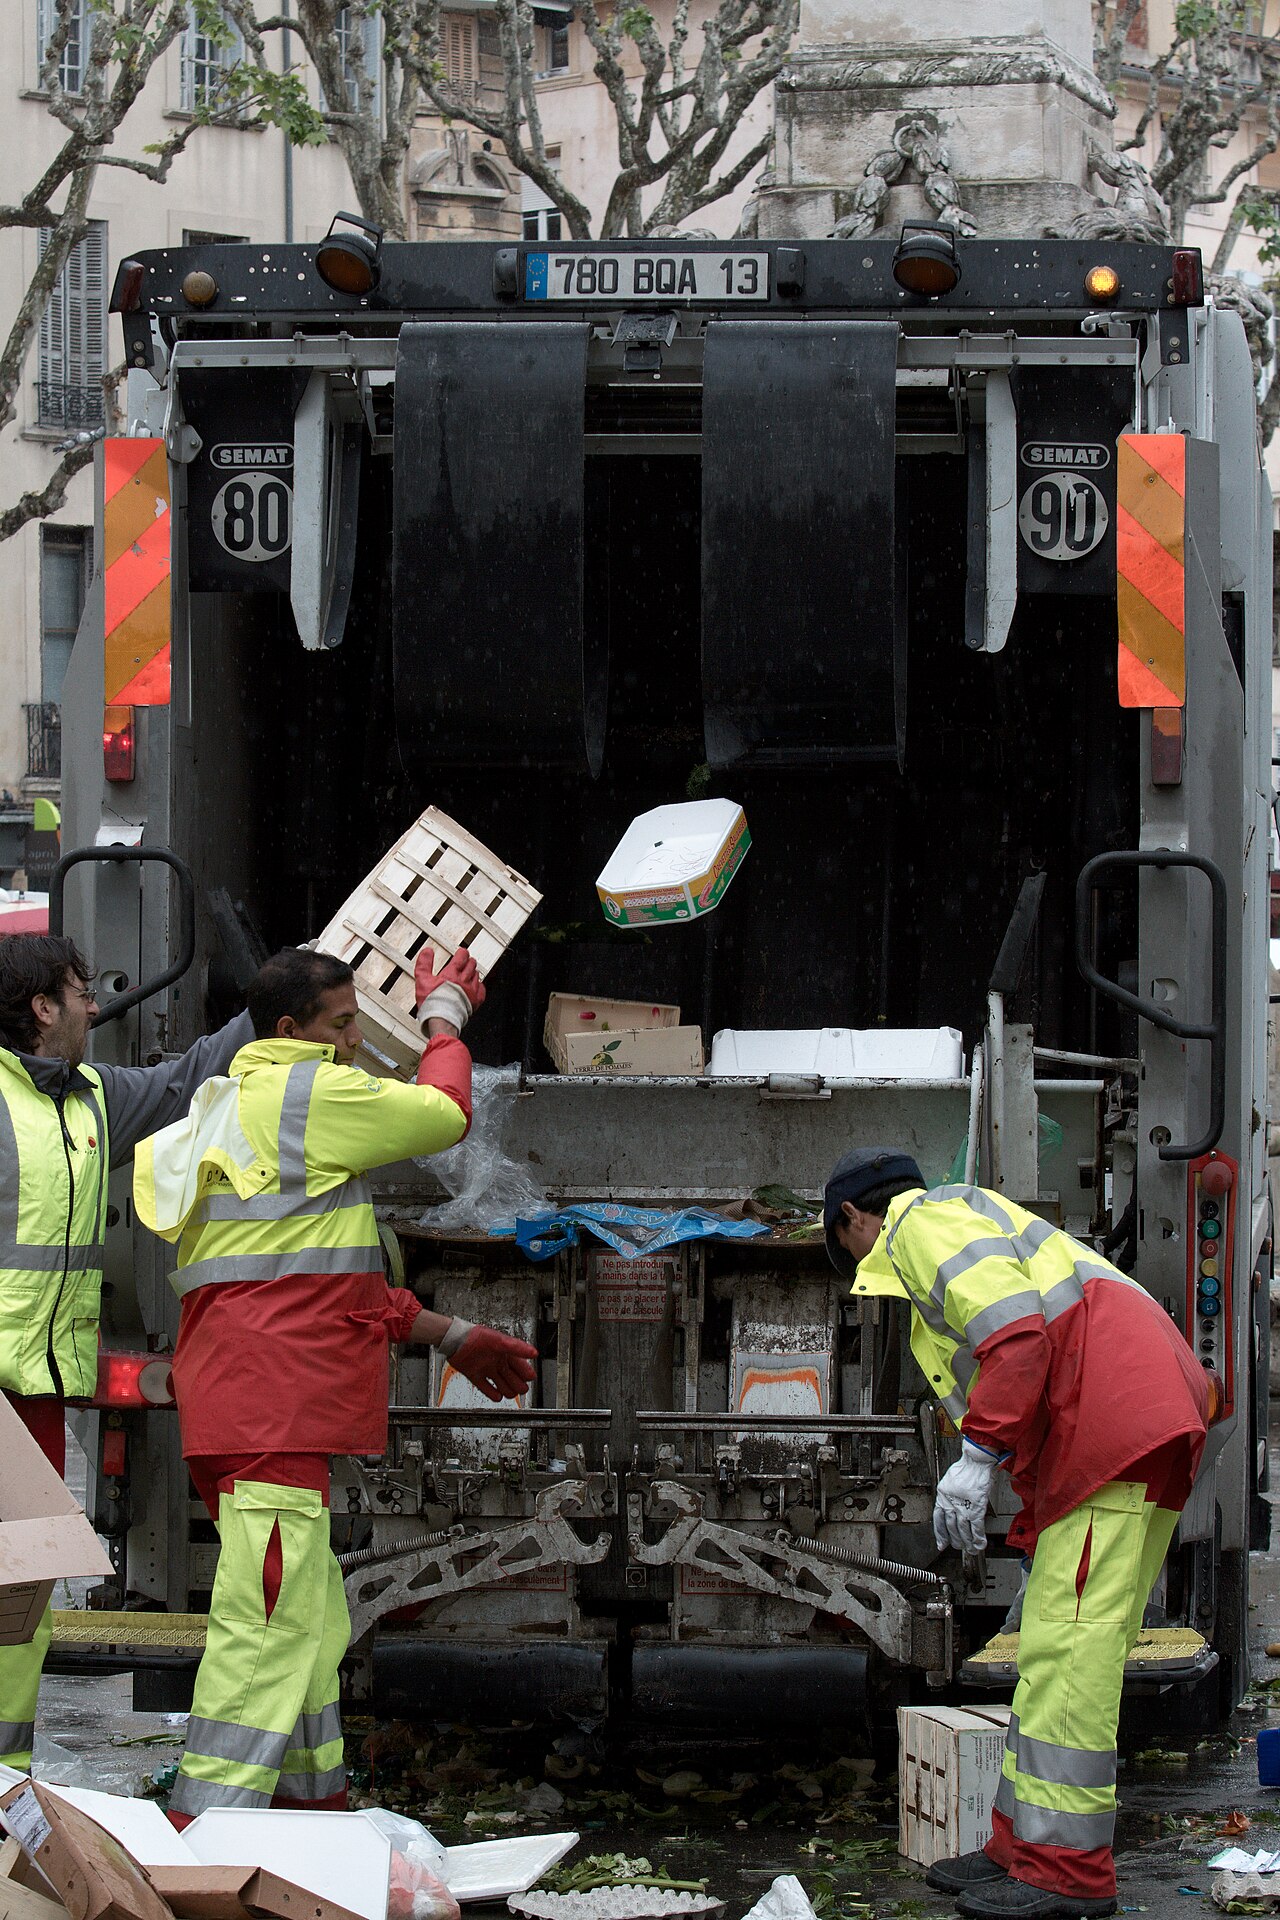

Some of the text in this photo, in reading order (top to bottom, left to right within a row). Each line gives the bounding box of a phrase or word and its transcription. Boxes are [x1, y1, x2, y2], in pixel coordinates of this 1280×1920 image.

[555, 258, 758, 295] 780 BQA 13
[532, 280, 541, 291] F
[220, 448, 288, 464] SEMAT
[1030, 447, 1100, 464] SEMAT
[223, 481, 289, 552] 80
[1030, 481, 1097, 552] 90
[605, 1063, 632, 1071] POMMES
[602, 1259, 614, 1269] Ne
[616, 1261, 631, 1270] pas
[602, 1271, 626, 1280] mains
[628, 1271, 648, 1280] dans
[650, 1271, 658, 1280] la
[607, 1295, 621, 1304] pas
[634, 1294, 659, 1304] placer
[600, 1306, 619, 1314] zone
[621, 1305, 631, 1314] de
[10, 1585, 37, 1593] Calibre
[687, 1579, 695, 1588] la
[697, 1580, 716, 1588] zone
[718, 1579, 729, 1588] de
